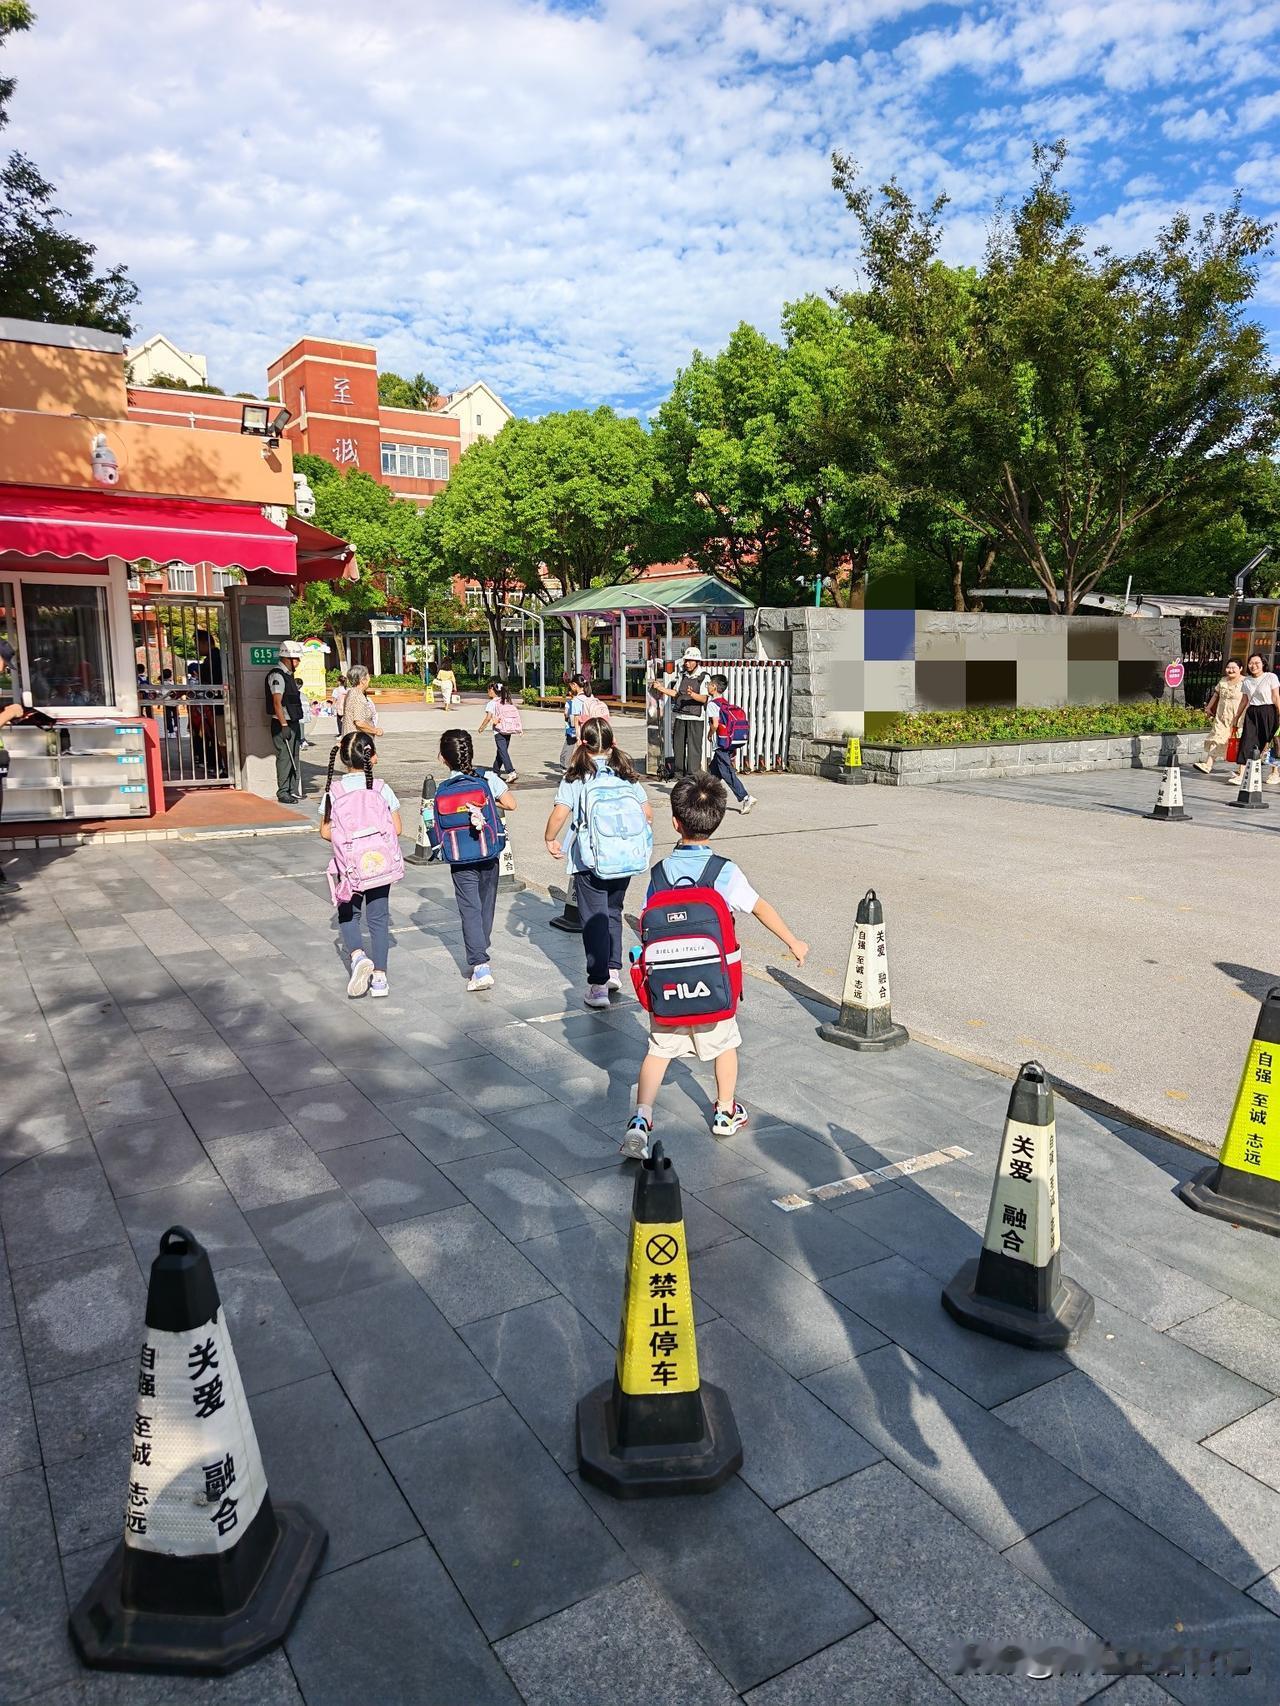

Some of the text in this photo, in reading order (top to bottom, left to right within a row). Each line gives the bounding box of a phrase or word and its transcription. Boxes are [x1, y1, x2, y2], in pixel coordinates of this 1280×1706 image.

[254, 649, 272, 659] 615
[857, 931, 867, 951] 自强
[876, 930, 886, 957] 关爱
[663, 981, 711, 1001] FILA
[853, 980, 863, 999] 志远
[1244, 1051, 1273, 1166] 自强 至诚 志远
[1000, 1135, 1035, 1253] 关爱 融合
[649, 1273, 678, 1386] 禁止停车
[137, 1343, 156, 1398] 自强
[188, 1337, 240, 1537] 关爱 融合
[126, 1482, 149, 1535] 志远
